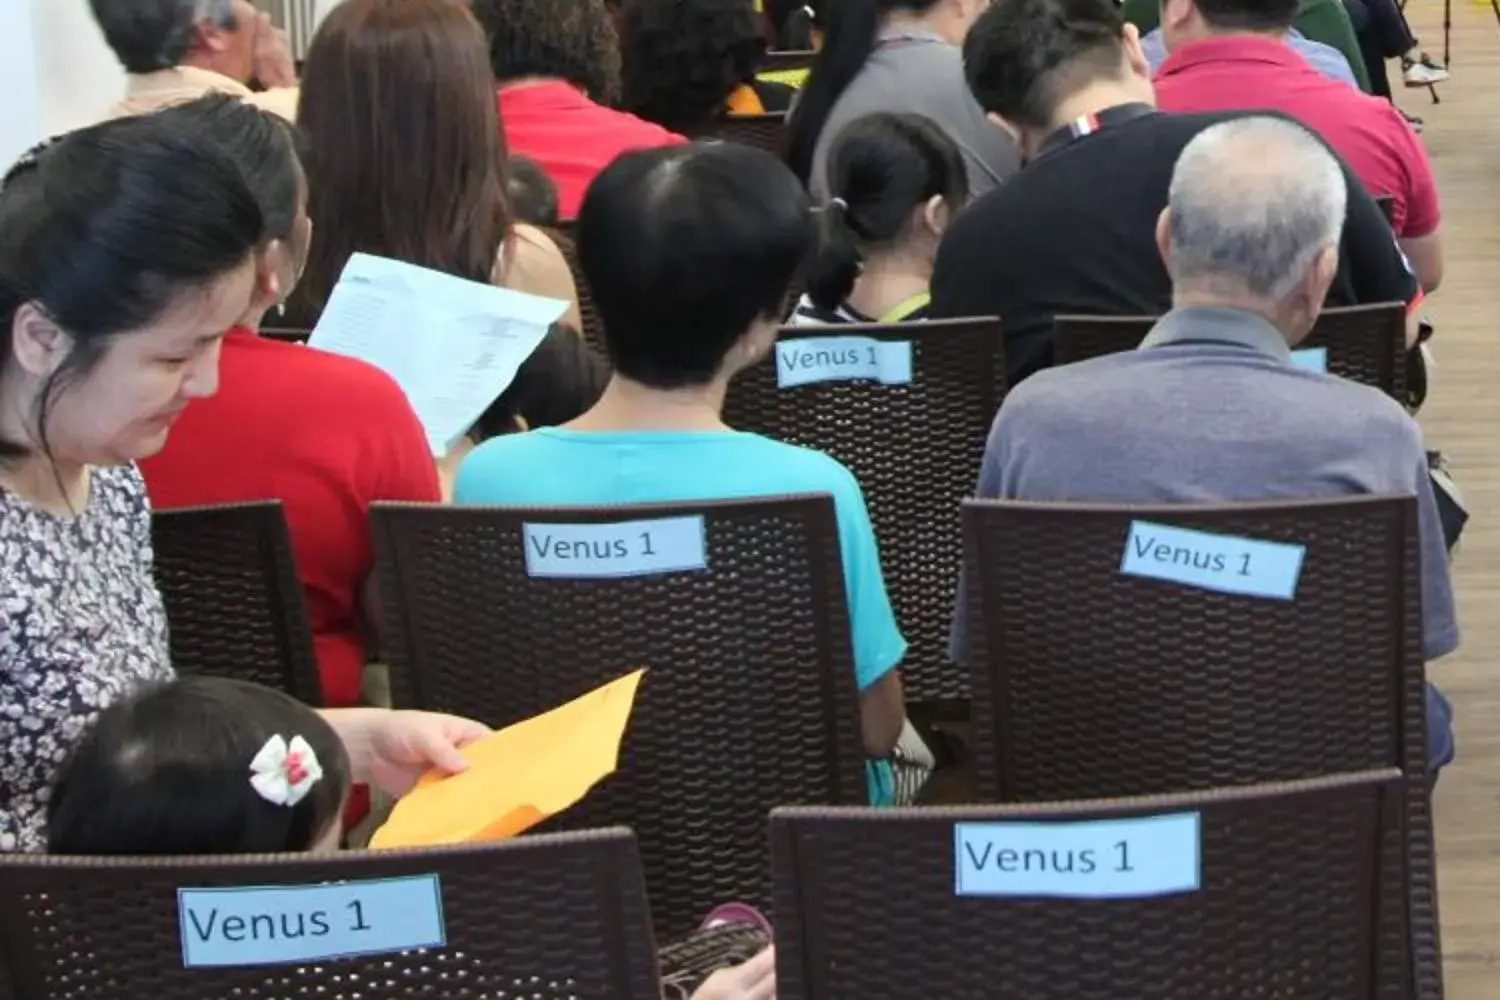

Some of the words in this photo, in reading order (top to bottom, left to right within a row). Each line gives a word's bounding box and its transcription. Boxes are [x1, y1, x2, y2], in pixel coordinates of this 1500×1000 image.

[782, 348, 860, 372] Venus
[866, 346, 878, 366] 1
[531, 534, 629, 559] Venus
[639, 532, 656, 556] 1
[1134, 534, 1225, 572] Venus
[1236, 552, 1252, 577] 1
[965, 840, 1097, 874] Venus
[1112, 839, 1135, 873] 1
[188, 906, 331, 942] Venus
[345, 898, 372, 932] 1
